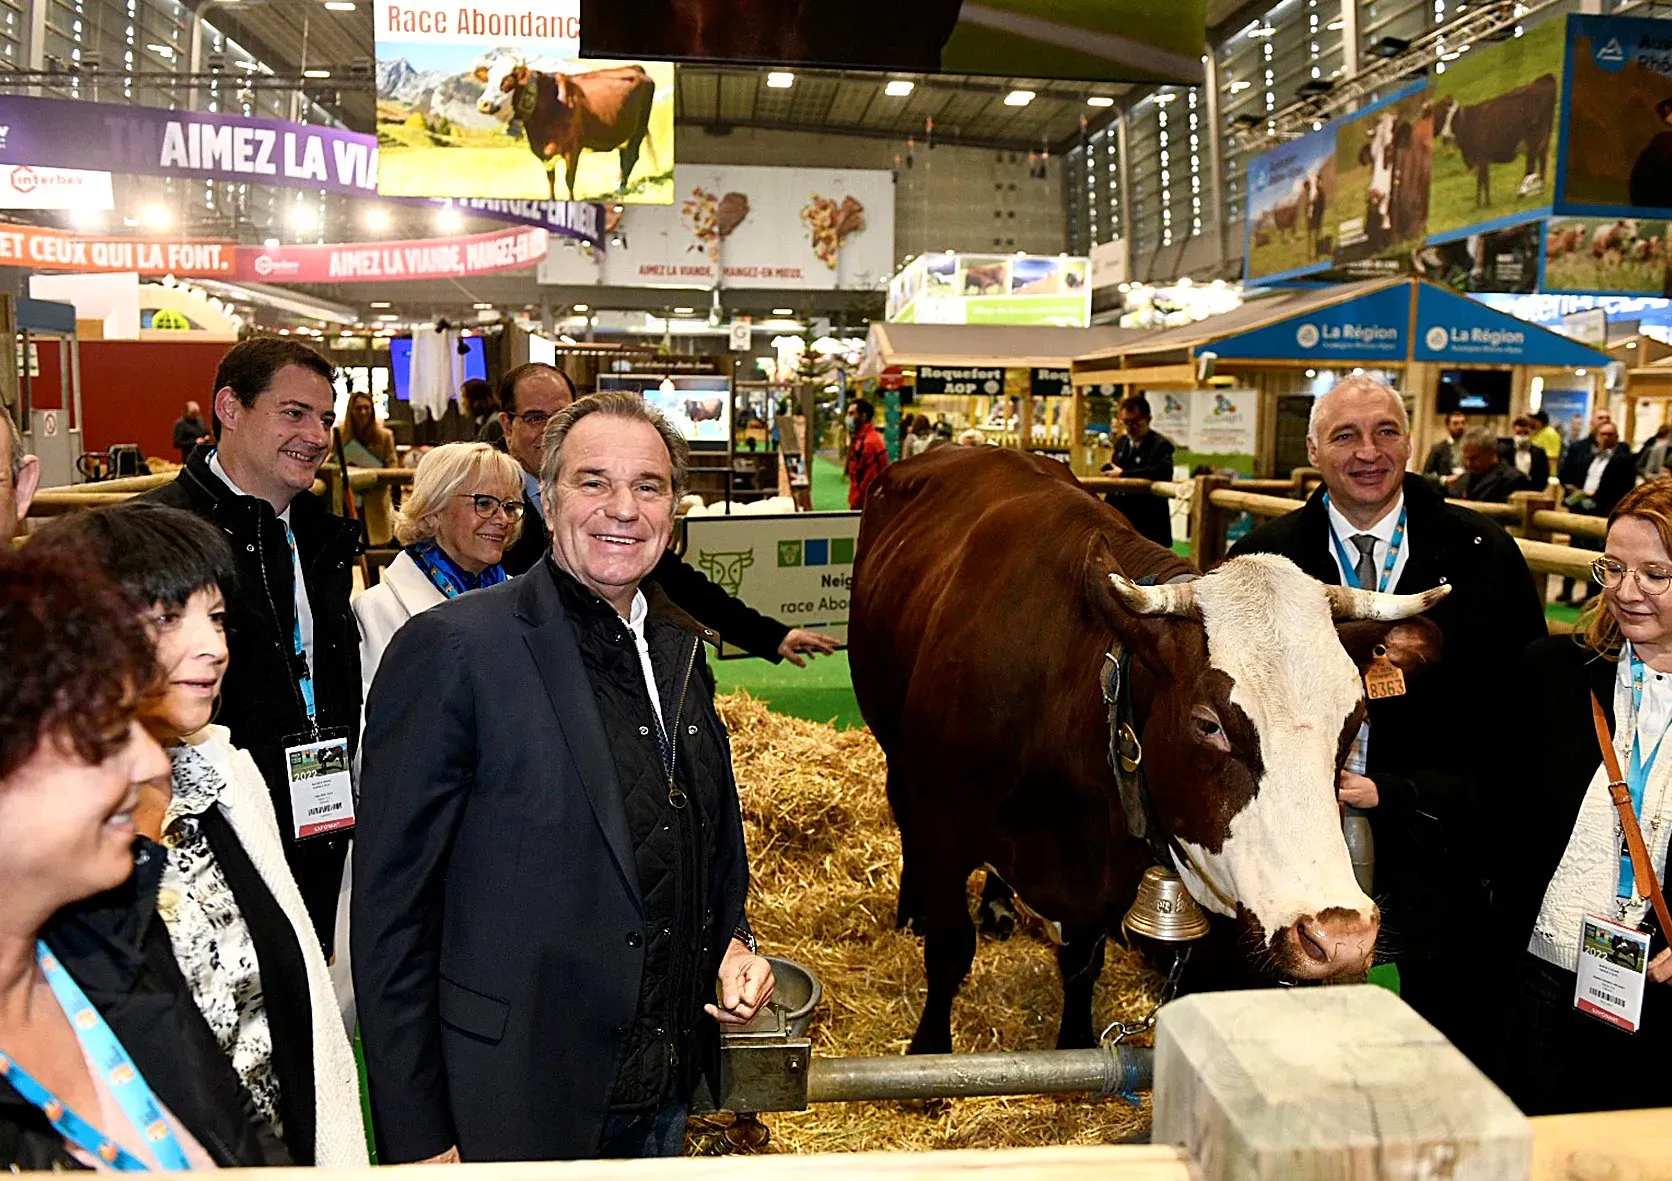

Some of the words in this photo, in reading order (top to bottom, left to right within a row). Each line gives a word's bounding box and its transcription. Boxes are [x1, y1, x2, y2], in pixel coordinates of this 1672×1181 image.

[388, 5, 447, 33] Race
[457, 8, 580, 39] Abondanc
[160, 121, 277, 174] AIMEZ
[284, 132, 328, 181] LA
[0, 231, 25, 258] ET
[29, 235, 87, 264] CEUX
[91, 242, 132, 268] QUI
[137, 243, 164, 269] LA
[168, 244, 229, 270] FONT.
[329, 250, 381, 276] AIMEZ
[383, 249, 407, 274] LA
[638, 265, 665, 276] AIMEZ
[666, 265, 678, 276] LA
[1321, 324, 1341, 339] La
[1343, 323, 1398, 343] Région
[1450, 327, 1469, 342] La
[1471, 327, 1525, 345] Région
[920, 367, 1001, 381] Roquefort
[1038, 369, 1071, 382] Roq
[944, 383, 977, 394] AOP
[821, 572, 853, 590] Neig
[780, 601, 814, 613] race
[818, 595, 849, 611] Abo
[1369, 679, 1404, 698] 8363
[293, 769, 318, 782] 2022
[1584, 945, 1608, 960] 2022
